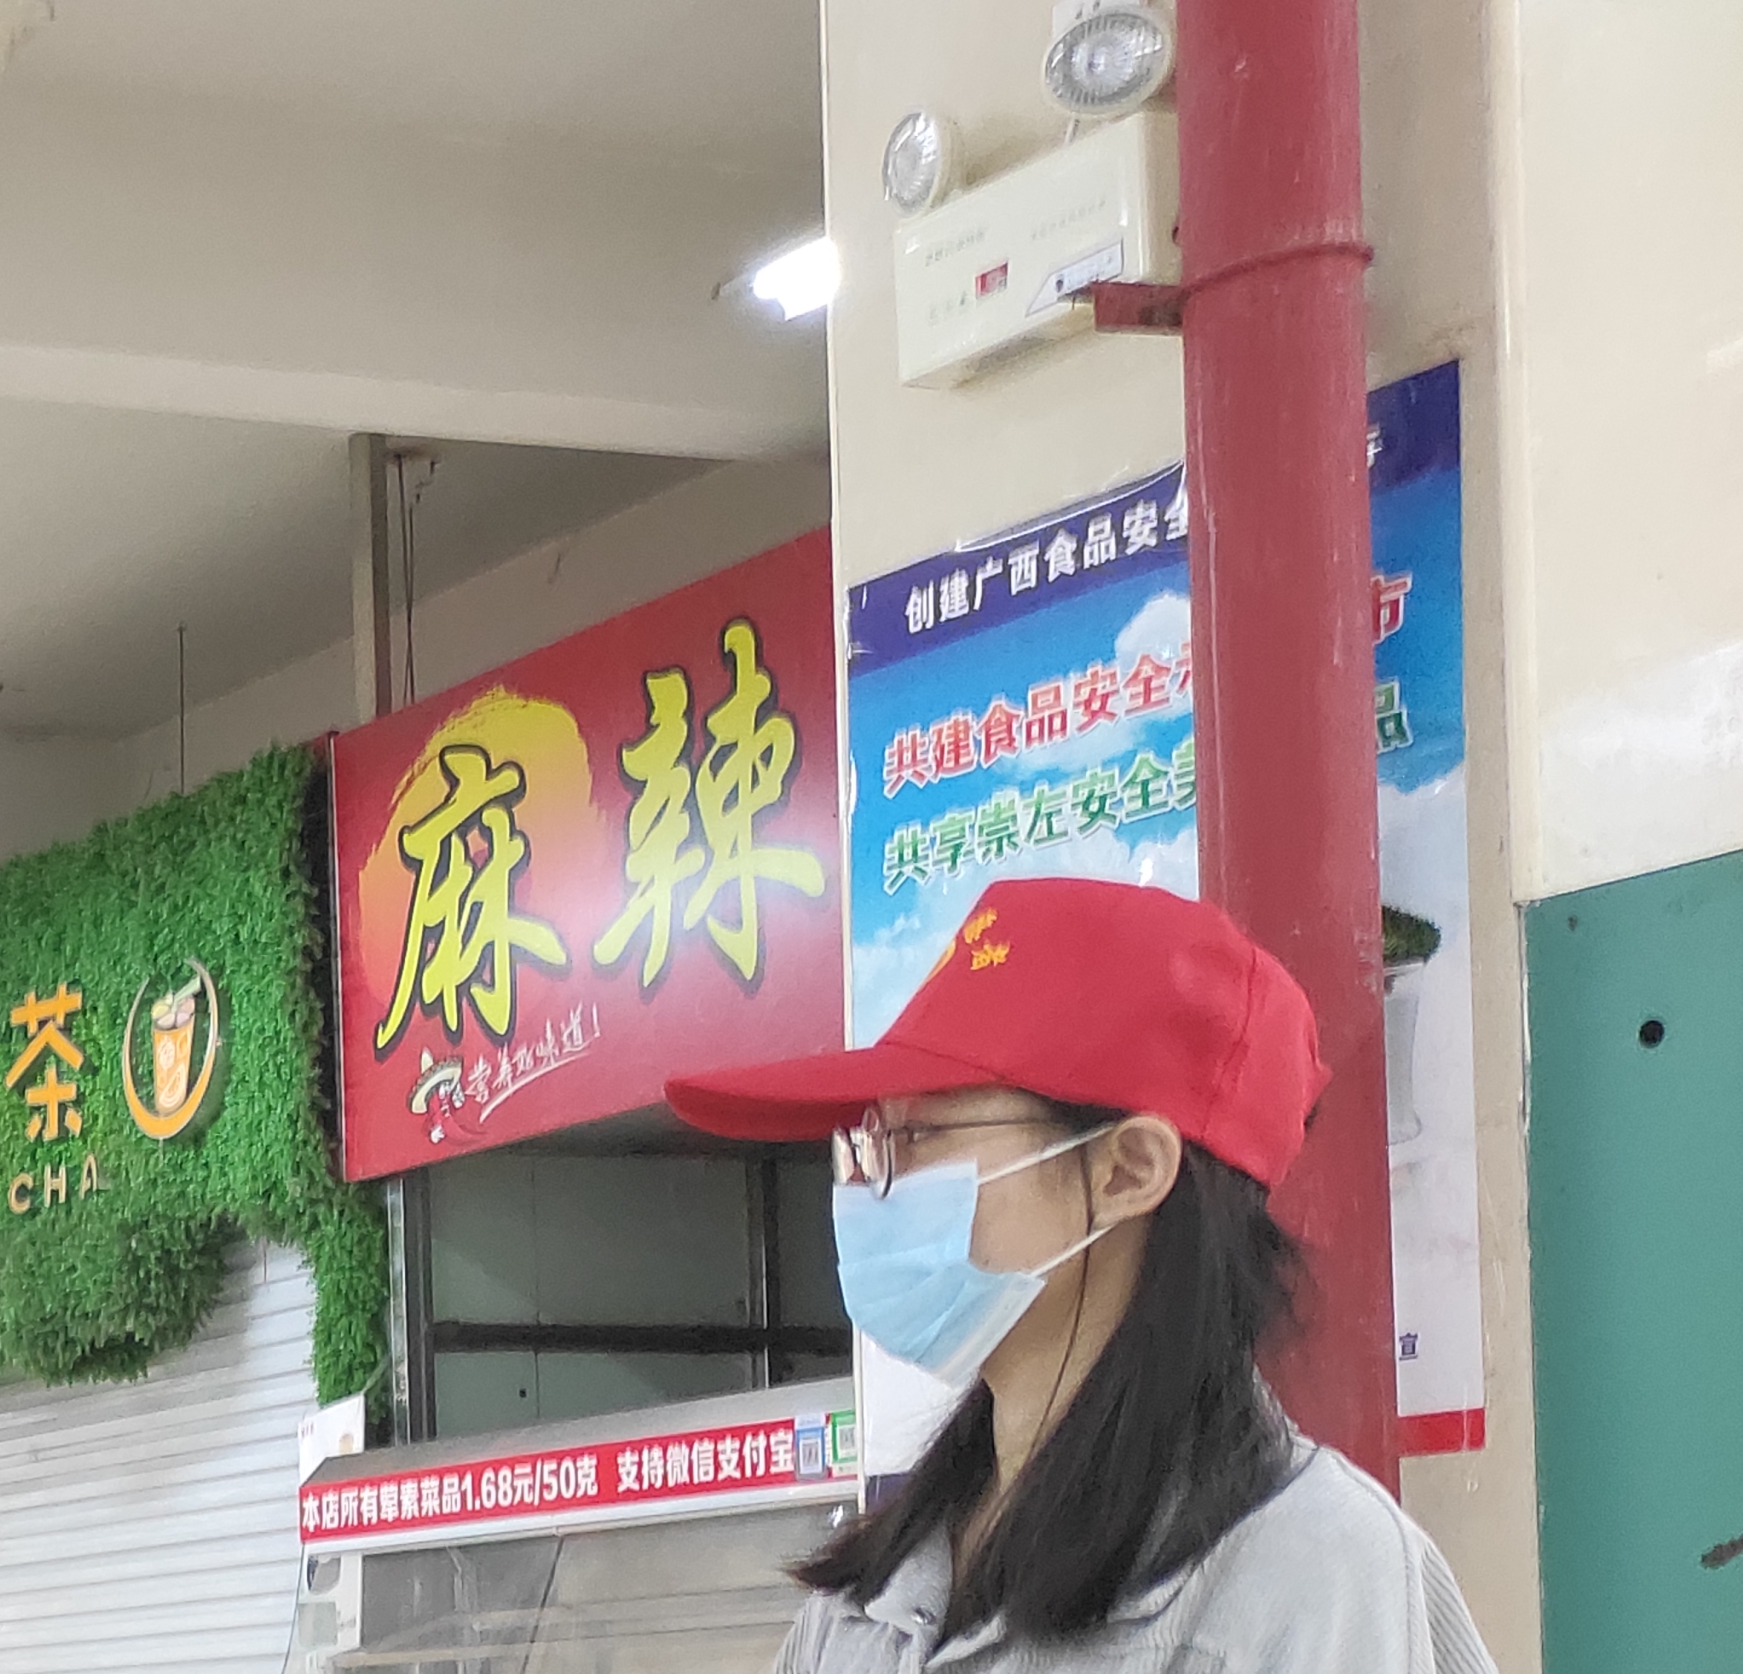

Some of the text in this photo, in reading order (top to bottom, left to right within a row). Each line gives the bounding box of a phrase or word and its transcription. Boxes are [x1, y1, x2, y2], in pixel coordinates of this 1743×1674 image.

[375, 620, 825, 1047] 麻辣
[9, 1153, 101, 1214] CHA
[616, 1428, 795, 1494] 支持微信支付宝
